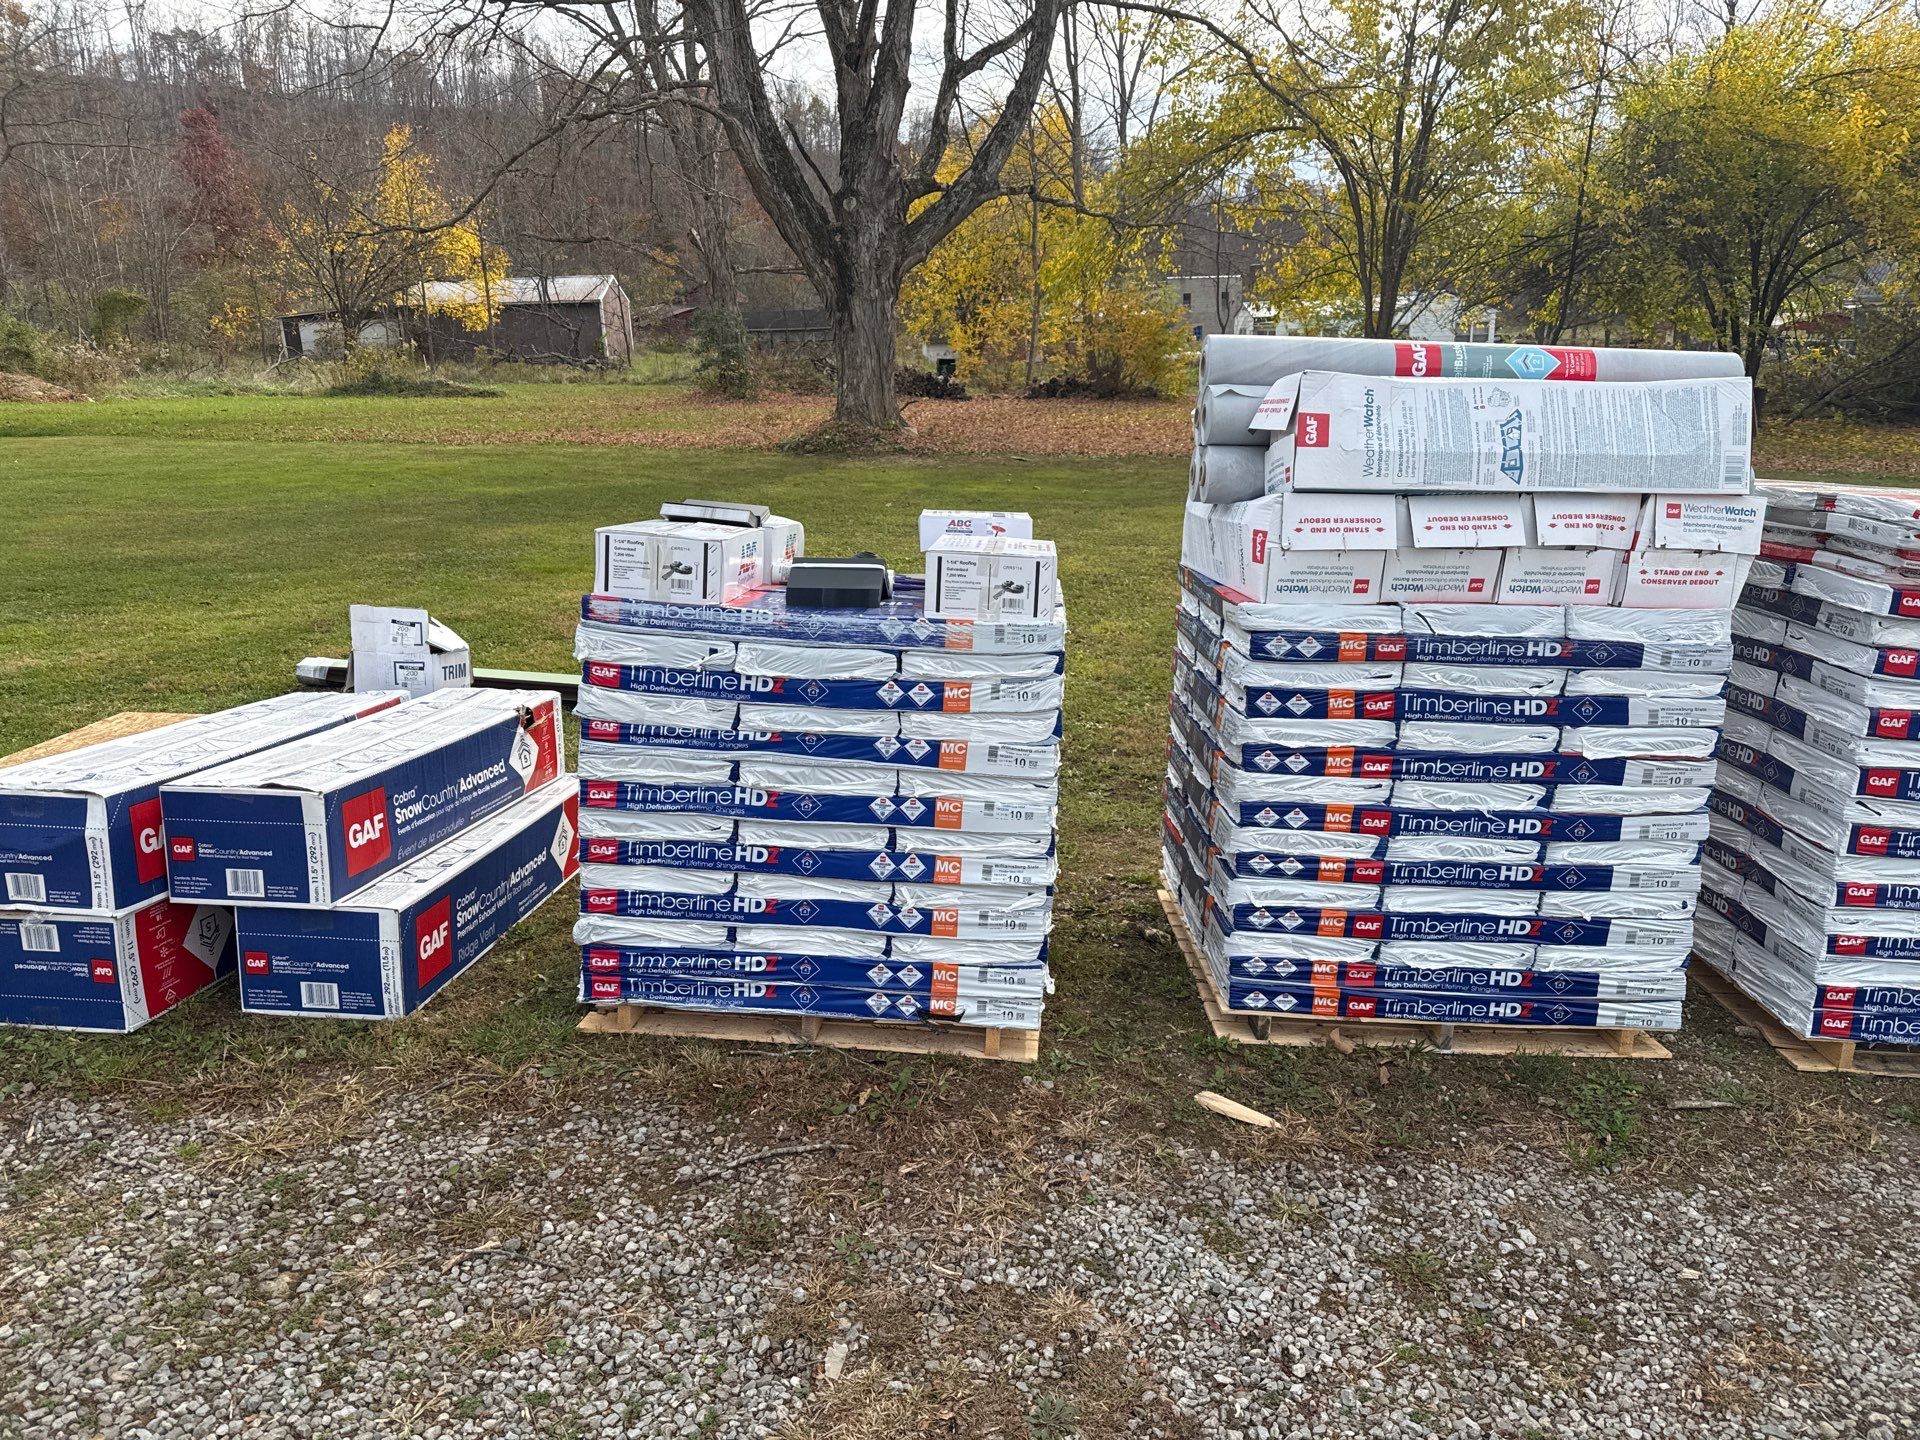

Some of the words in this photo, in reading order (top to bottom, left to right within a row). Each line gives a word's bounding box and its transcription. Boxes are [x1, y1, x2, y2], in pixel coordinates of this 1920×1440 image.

[1412, 344, 1426, 376] GAF
[1306, 416, 1317, 445] GAF
[1689, 578, 1719, 586] DEBOUT
[1022, 634, 1034, 644] 10
[1340, 640, 1366, 651] MC
[1378, 644, 1404, 653] GAF
[1888, 655, 1915, 664] GAF
[442, 663, 467, 680] TRIM
[591, 667, 618, 678] GAF
[630, 682, 647, 691] High
[721, 691, 750, 700] Shingles
[944, 688, 970, 698] MC
[1016, 692, 1029, 700] 10
[1330, 698, 1355, 708] MC
[1366, 701, 1392, 711] GAF
[1405, 712, 1422, 721] High
[1495, 716, 1525, 724] Shingles
[1880, 718, 1908, 727] GAF
[591, 722, 618, 732] GAF
[630, 735, 648, 744] High
[941, 743, 967, 754] MC
[1014, 758, 1026, 768] 10
[1327, 757, 1352, 767] MC
[1364, 762, 1389, 771] GAF
[1870, 778, 1896, 786] GAF
[590, 790, 614, 799] GAF
[626, 802, 644, 811] High
[715, 806, 745, 815] Shingles
[936, 802, 961, 812] MC
[1010, 811, 1022, 820] 10
[1327, 813, 1352, 823] MC
[1363, 819, 1388, 827] GAF
[349, 812, 384, 849] GAF
[418, 837, 427, 849] de
[1860, 836, 1886, 844] GAF
[174, 845, 192, 853] GAF
[590, 845, 616, 854] GAF
[716, 861, 746, 870] Shingles
[936, 860, 960, 873] MC
[1320, 862, 1345, 871] MC
[1356, 867, 1380, 876] GAF
[1848, 888, 1875, 897] GAF
[589, 896, 615, 905] GAF
[715, 913, 744, 921] Shingles
[933, 911, 957, 922] MC
[1320, 916, 1345, 926] MC
[458, 917, 478, 940] Premium
[479, 904, 497, 922] Exhaust
[1356, 921, 1380, 931] GAF
[420, 920, 449, 960] GAF
[458, 940, 479, 962] Ridge
[480, 923, 496, 943] Vent
[247, 960, 266, 968] GAF
[592, 958, 617, 967] GAF
[1314, 964, 1338, 974] MC
[933, 970, 957, 982] MC
[594, 983, 618, 992] GAF
[1827, 992, 1853, 1000] GAF
[931, 1000, 955, 1010] MC
[1315, 997, 1338, 1007] MC
[1349, 1002, 1373, 1010] GAF
[1864, 1004, 1881, 1013] High
[1001, 1011, 1013, 1020] 10
[1824, 1020, 1849, 1028] GAF
